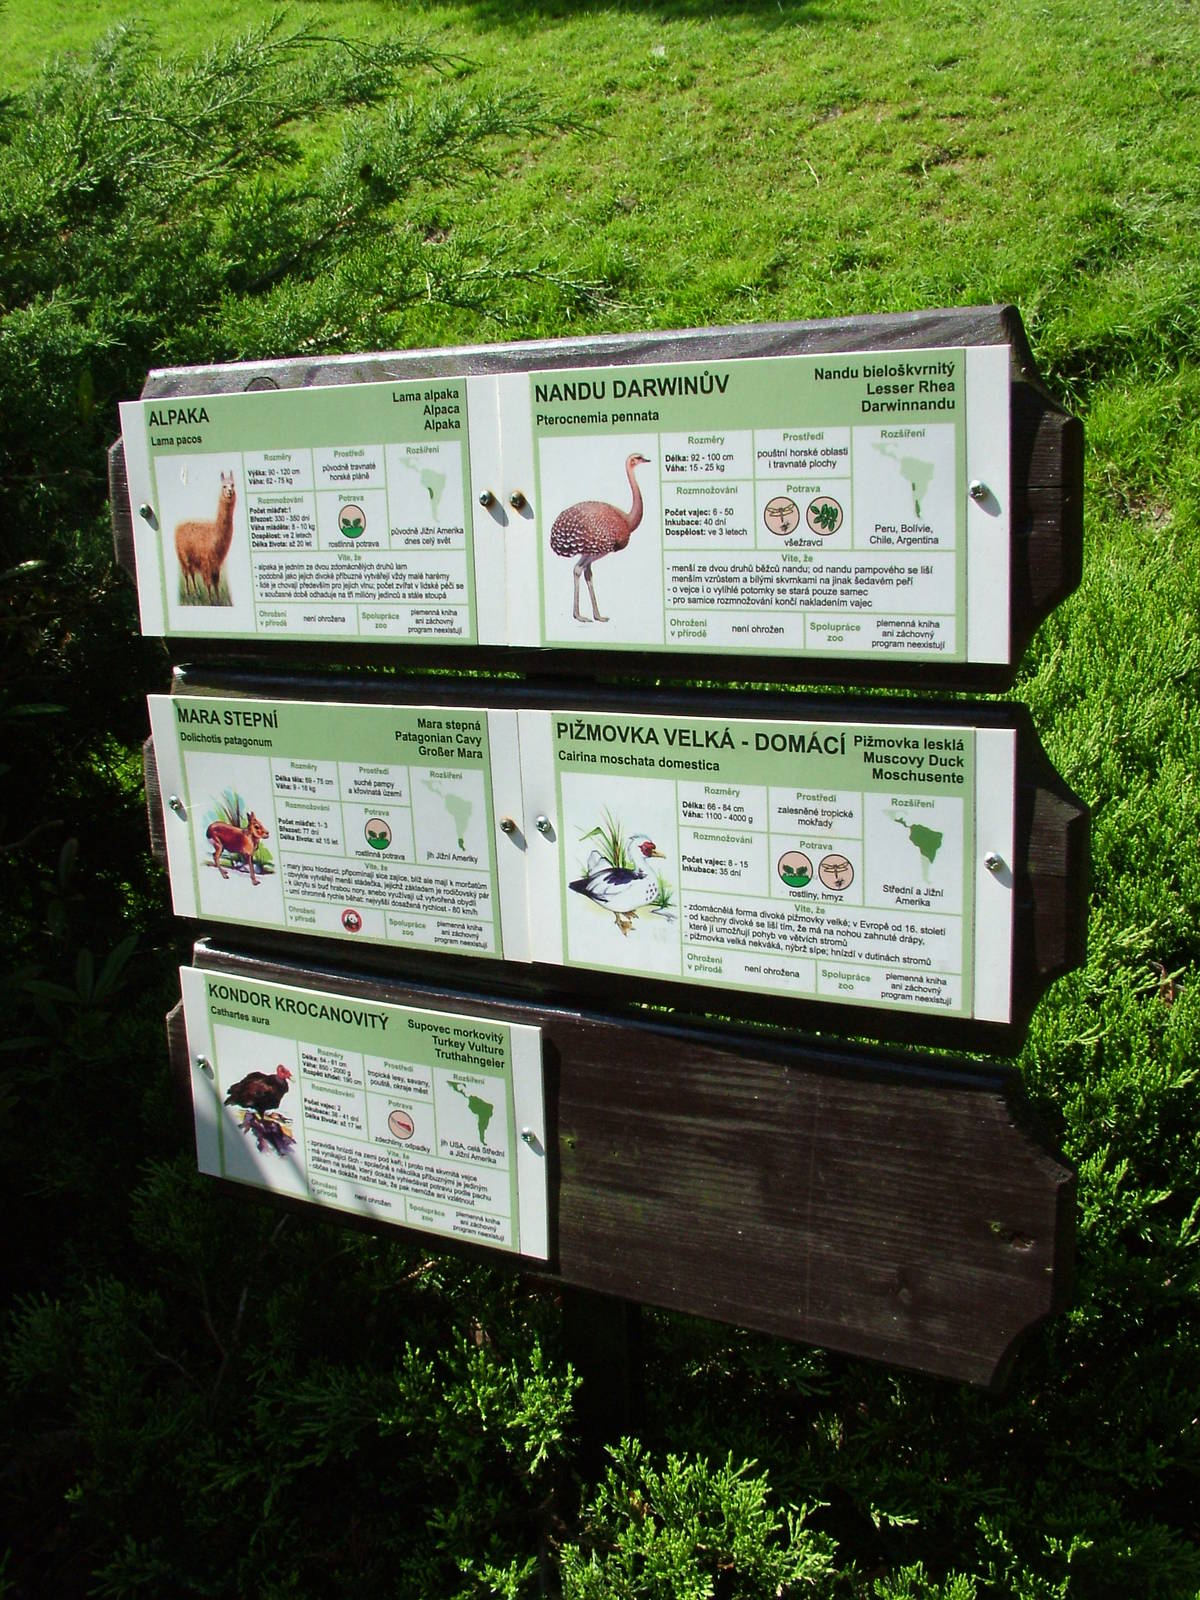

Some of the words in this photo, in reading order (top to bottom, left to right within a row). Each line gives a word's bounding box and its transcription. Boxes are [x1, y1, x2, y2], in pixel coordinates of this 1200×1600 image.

[814, 366, 859, 380] Nandu
[863, 361, 955, 378] bieloškvrnitý
[392, 392, 421, 403] Lama
[424, 387, 459, 402] alpaka
[535, 380, 605, 403] NANDU
[612, 370, 730, 399] DARWINŮV
[866, 382, 915, 395] Lesser
[918, 379, 955, 393] Rhea
[423, 404, 460, 417] Alpaca
[861, 396, 955, 413] Darwinnandu
[149, 407, 210, 427] ALPAKA
[423, 418, 461, 432] Alpaka
[536, 411, 608, 426] Pterocnemia
[611, 409, 659, 425] pennata
[150, 436, 174, 446] Lama
[176, 435, 202, 447] pacos
[786, 484, 821, 493] Potrava
[176, 706, 221, 725] MARA
[223, 709, 278, 729] STEPNÍ
[417, 717, 443, 729] Mara
[445, 720, 481, 733] stepná
[179, 731, 222, 744] Dolichotis
[223, 735, 273, 748] patagonum
[394, 730, 453, 744] Patagonian
[455, 733, 482, 747] Cavy
[556, 719, 660, 745] PIŽMOVKA
[663, 726, 735, 750] VELKÁ
[754, 730, 846, 755] DOMÁCÍ
[854, 735, 920, 749] Pižmovka
[923, 737, 964, 751] lesklá
[418, 745, 455, 757] Großer
[457, 747, 483, 759] Mara
[558, 749, 597, 763] Cairina
[599, 754, 655, 767] moschata
[658, 756, 720, 771] domestica
[863, 751, 925, 768] Muscovy
[928, 754, 964, 768] Duck
[872, 767, 964, 784] Moschusente
[799, 840, 833, 851] Potrava
[208, 983, 271, 1009] KONDOR
[274, 995, 389, 1031] KROCANOVITÝ
[210, 1005, 250, 1022] Cathartes
[251, 1015, 270, 1026] aura
[407, 1018, 451, 1035] Supovec
[453, 1028, 504, 1045] morkovitý
[431, 1034, 466, 1051] Turkey
[467, 1040, 504, 1056] Vulture
